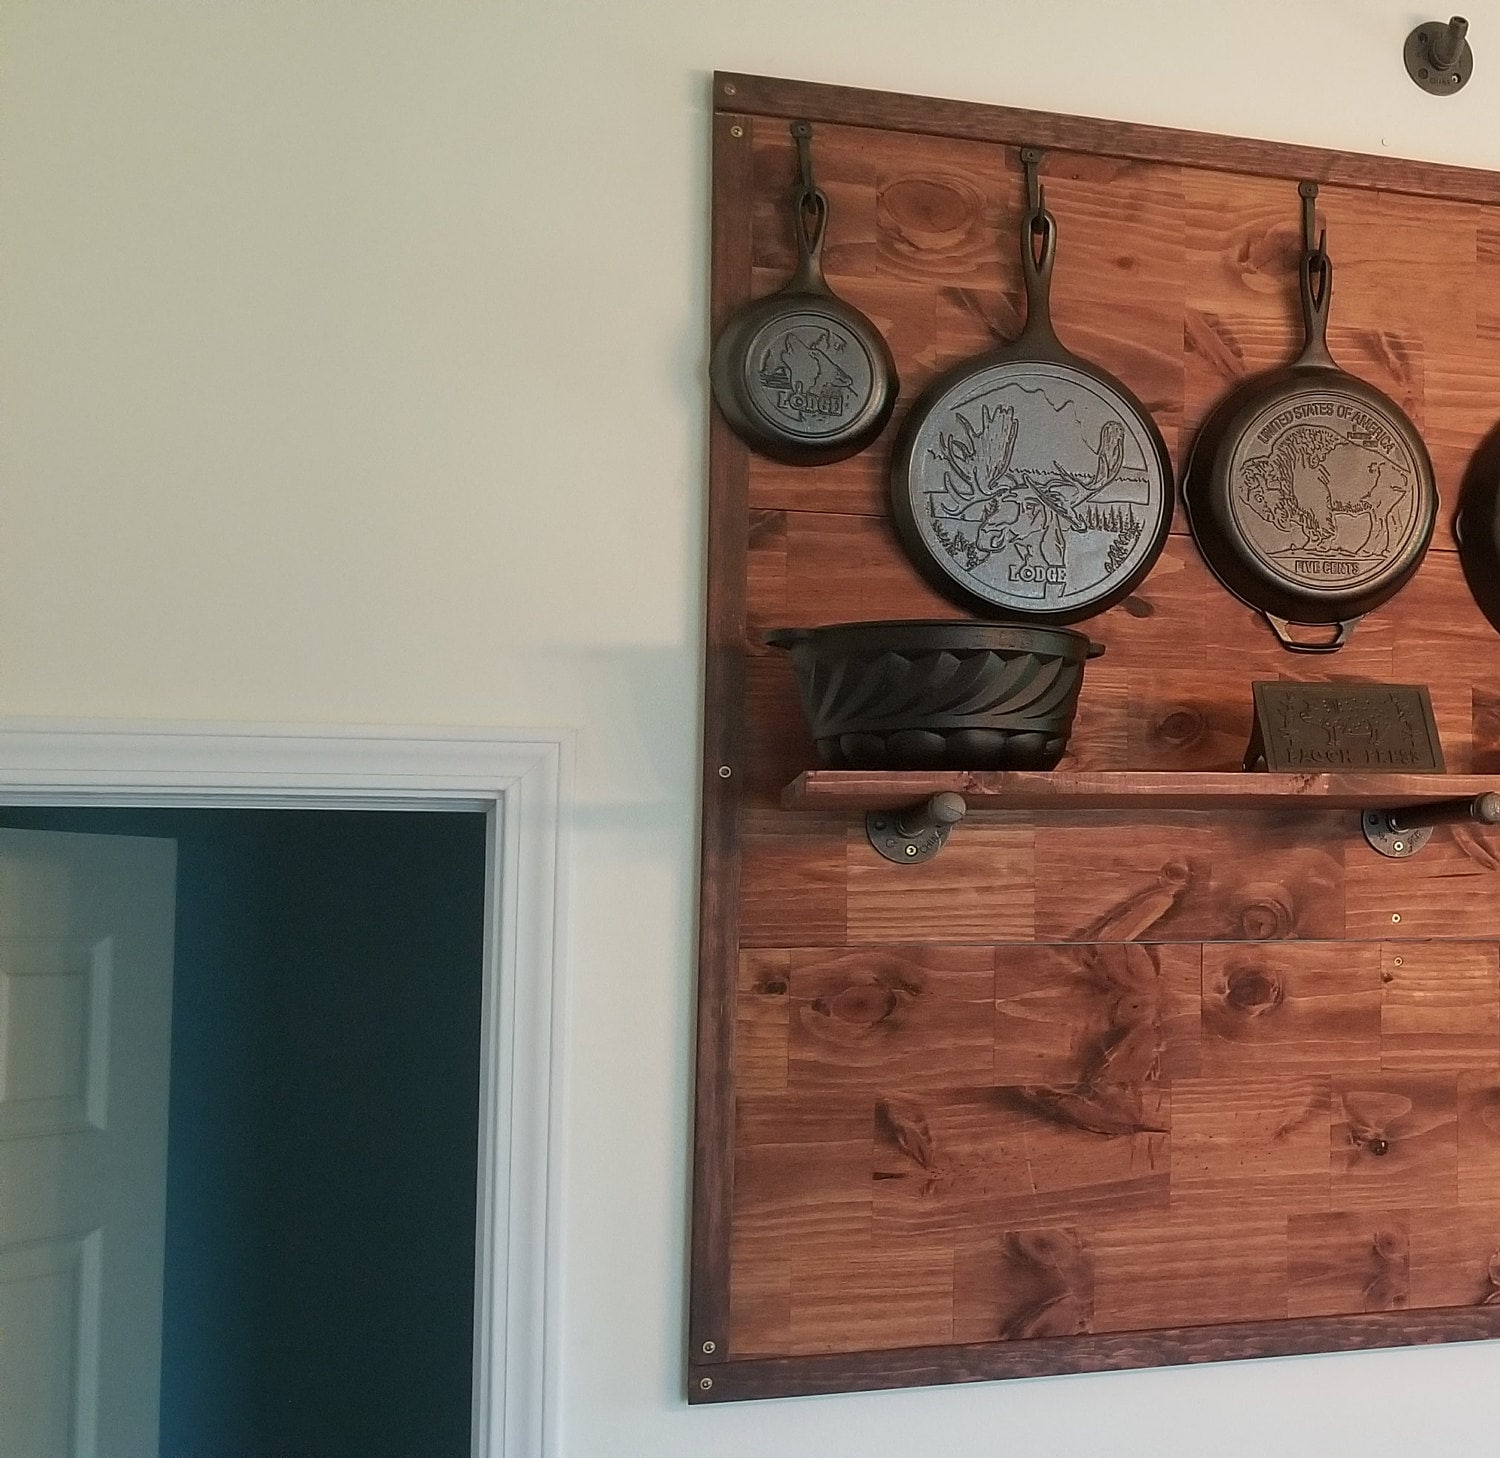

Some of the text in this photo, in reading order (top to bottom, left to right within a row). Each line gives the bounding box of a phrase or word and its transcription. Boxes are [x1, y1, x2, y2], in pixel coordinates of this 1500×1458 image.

[777, 381, 844, 417] LODGE
[1257, 411, 1296, 445] UNITED
[1293, 402, 1335, 420] STATES
[1336, 404, 1353, 420] OF
[1352, 410, 1397, 455] AMERICA
[1008, 558, 1067, 583] LODGE
[1295, 560, 1360, 576] FIVE CENTS
